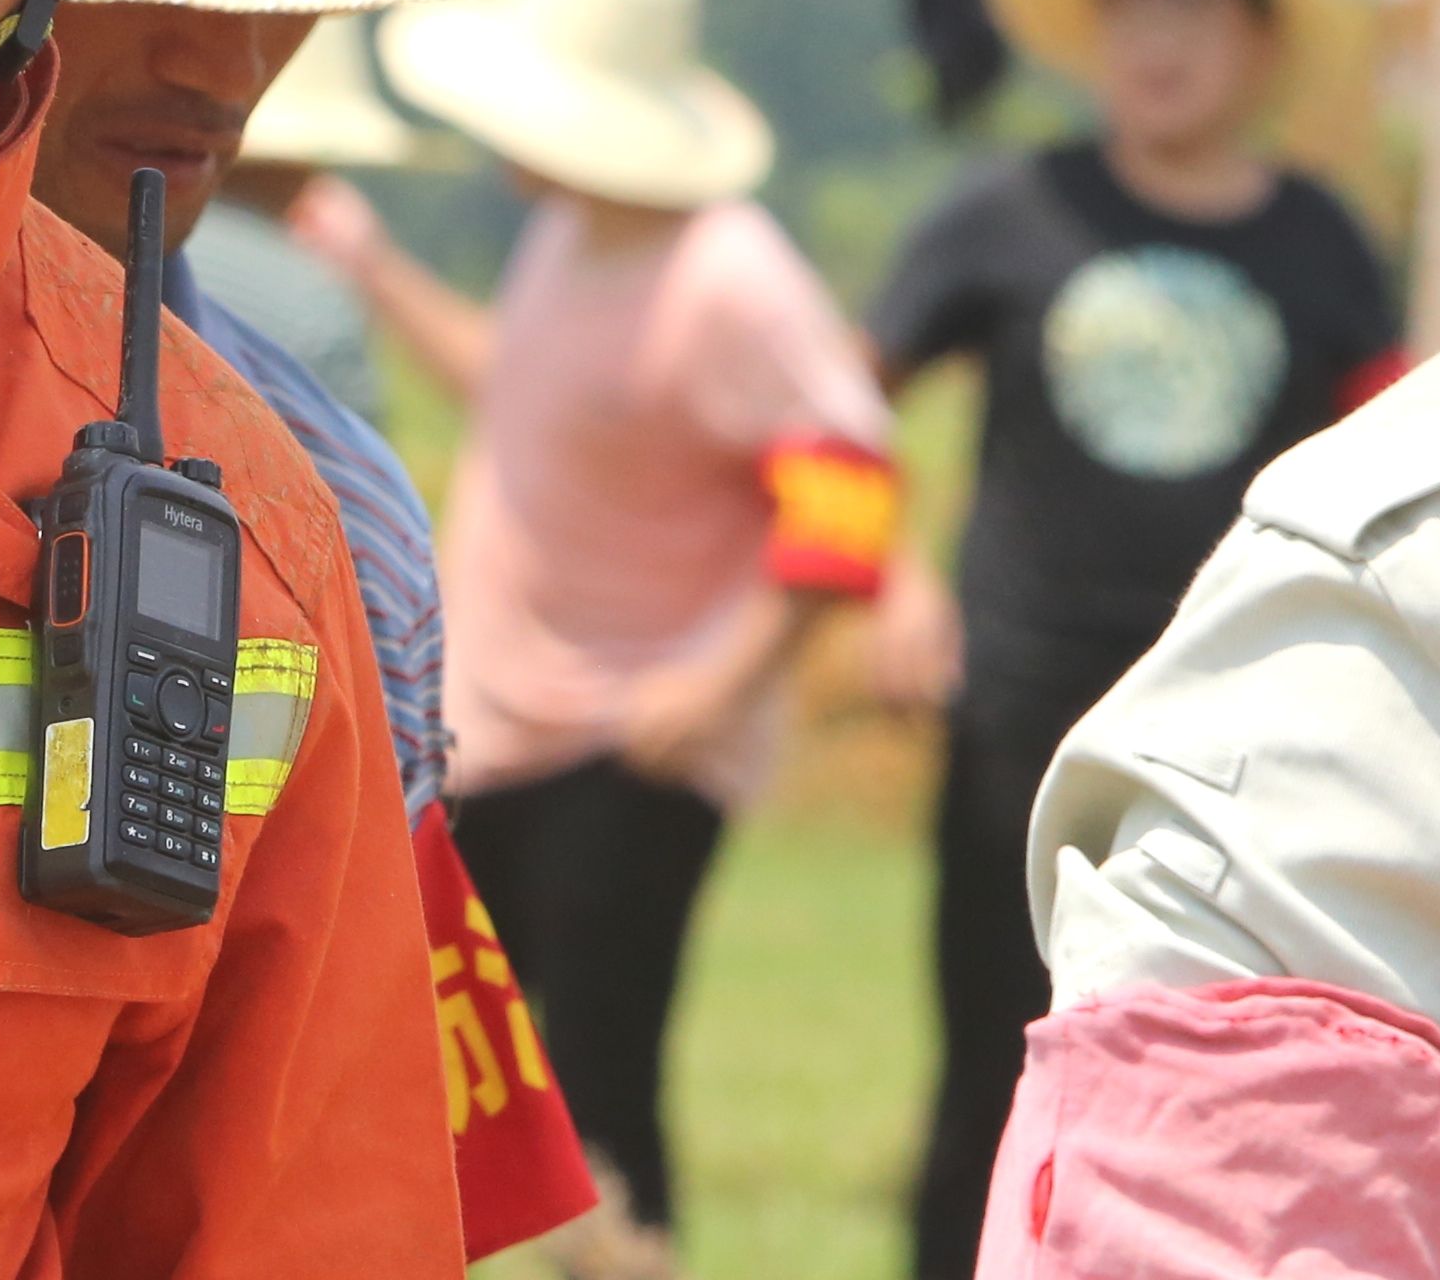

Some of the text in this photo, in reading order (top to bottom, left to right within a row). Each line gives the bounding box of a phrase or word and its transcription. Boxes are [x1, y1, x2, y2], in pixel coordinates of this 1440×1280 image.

[164, 503, 203, 532] Hytera
[169, 753, 176, 765] 2
[129, 770, 136, 781] 4
[204, 766, 211, 778] 3
[167, 782, 174, 793] 5
[128, 797, 135, 809] 7
[202, 794, 210, 806] 6
[166, 809, 173, 821] 8
[201, 821, 208, 833] 9
[166, 837, 173, 849] 0
